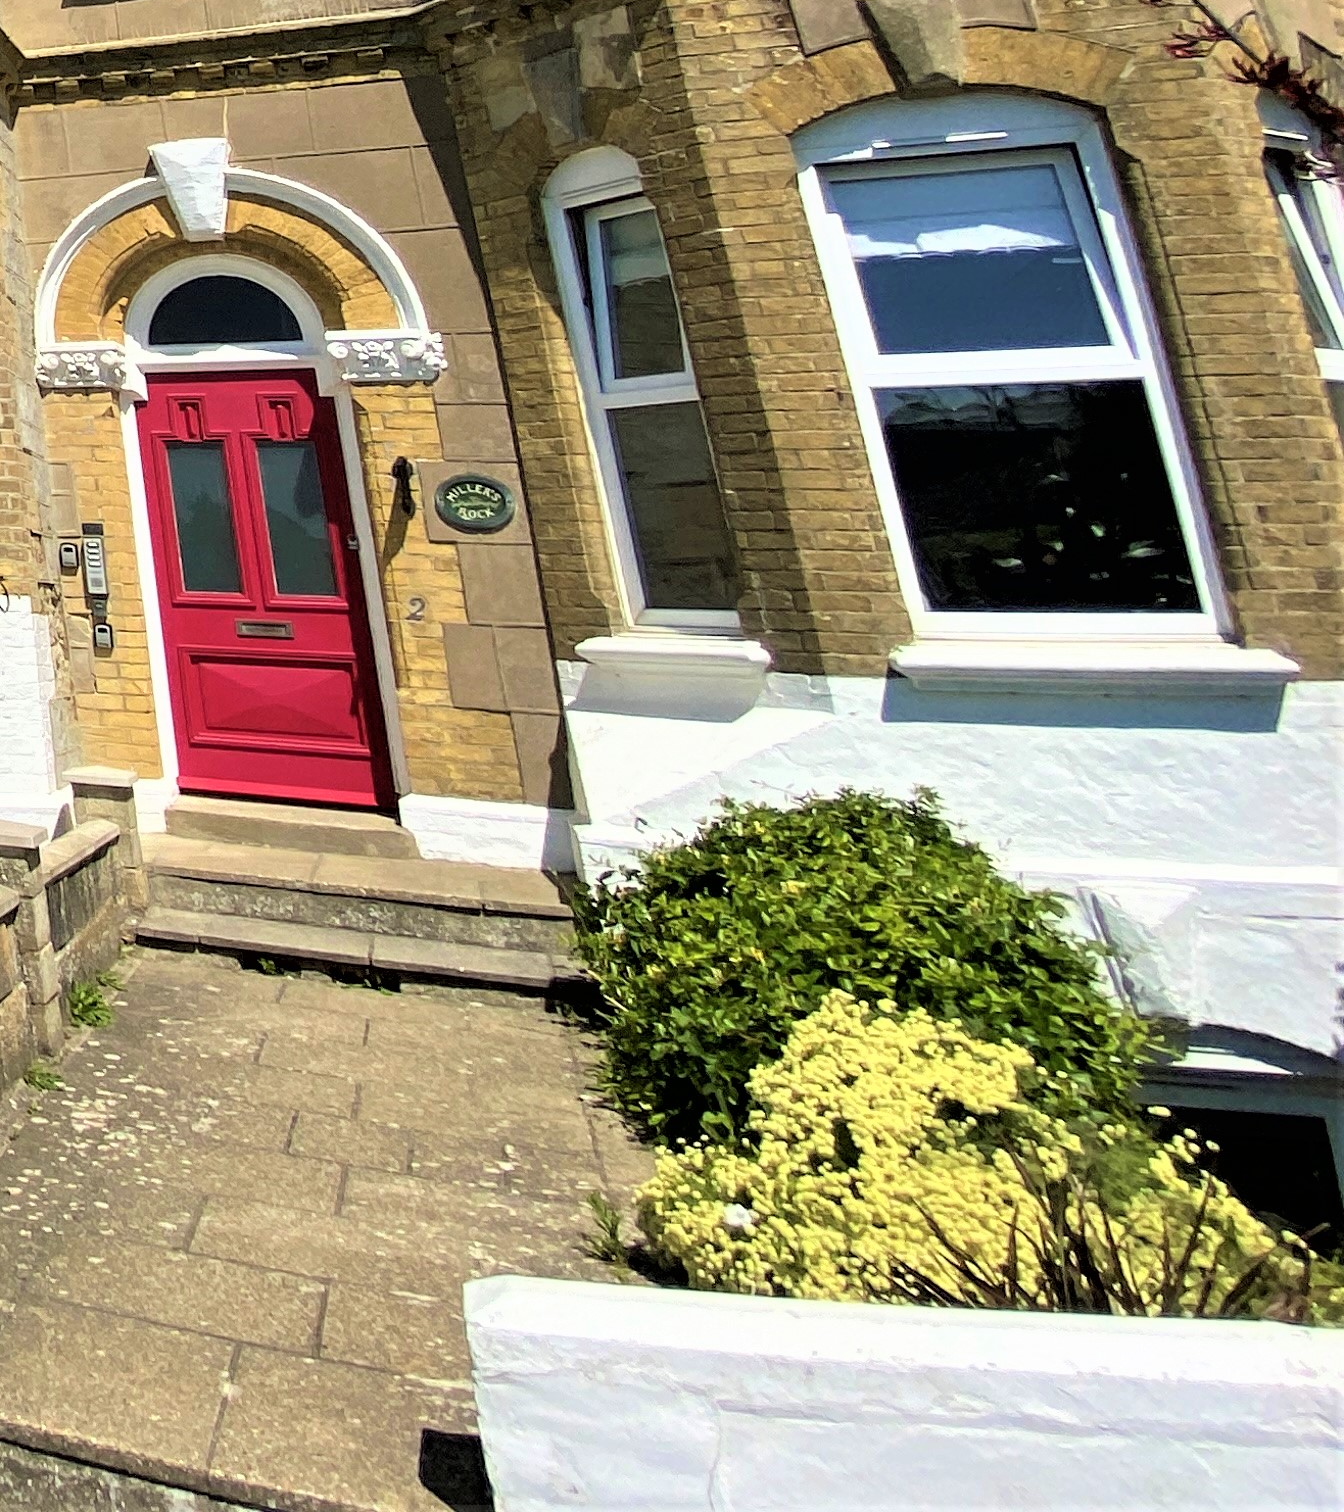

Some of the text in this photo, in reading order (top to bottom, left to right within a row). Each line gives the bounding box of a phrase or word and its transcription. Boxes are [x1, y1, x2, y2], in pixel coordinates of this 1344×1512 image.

[446, 484, 502, 502] MILLER'S
[456, 507, 495, 520] ROCK
[405, 597, 425, 621] 2
